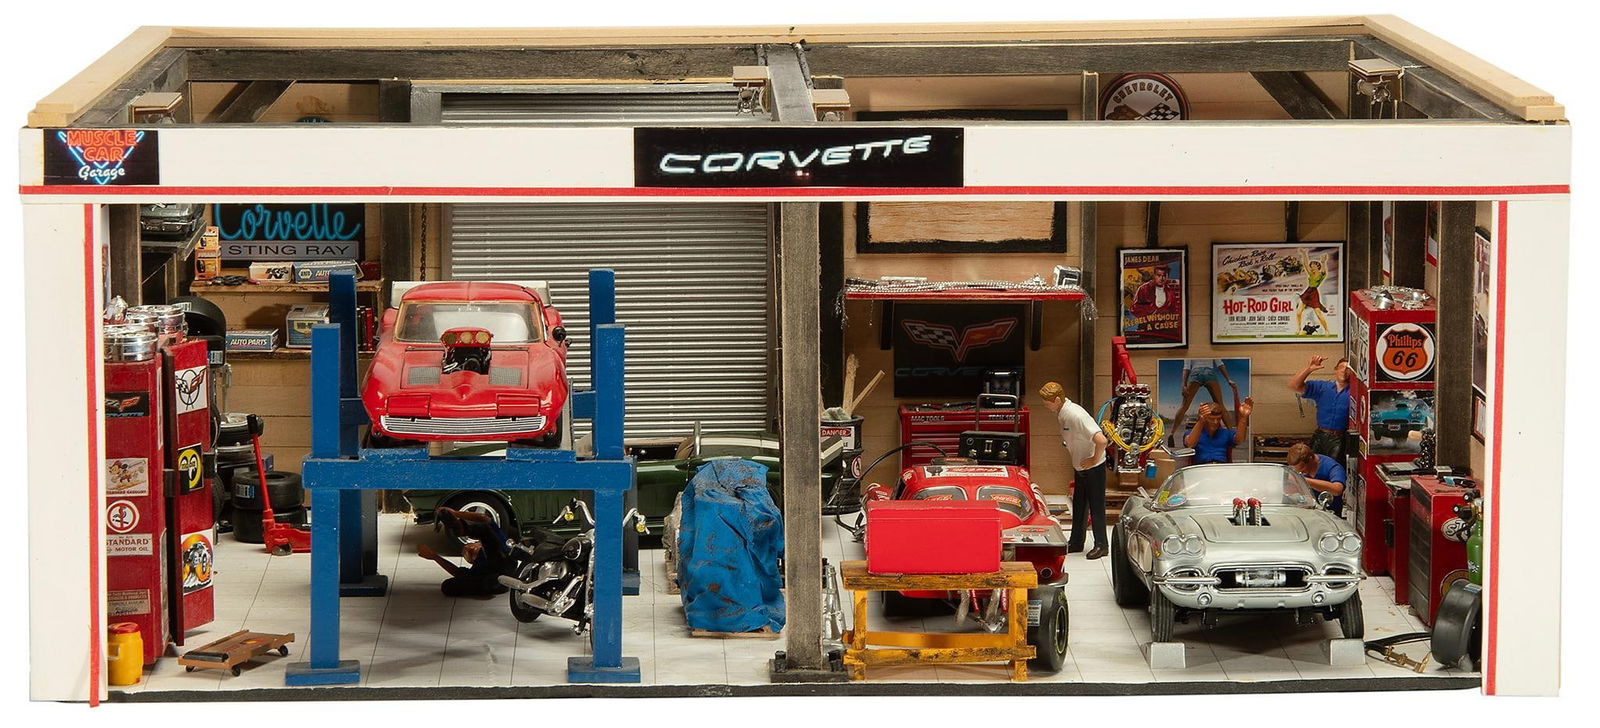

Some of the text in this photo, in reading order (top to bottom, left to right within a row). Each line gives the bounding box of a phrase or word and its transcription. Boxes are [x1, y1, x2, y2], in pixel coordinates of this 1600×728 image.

[1112, 81, 1173, 104] CHEVROLET
[66, 130, 137, 147] MUSCLE
[83, 147, 125, 162] CAR
[659, 134, 933, 174] CORVETTE
[78, 165, 126, 181] Garage
[228, 244, 297, 256] STING
[305, 244, 350, 256] RAY
[1124, 255, 1142, 265] JAMES
[1222, 296, 1294, 315] HOT-ROD GIRL
[1146, 321, 1179, 331] A CAUSE
[230, 338, 267, 346] AUTO PARTS
[1387, 333, 1423, 349] Phillips
[1392, 350, 1419, 369] 66
